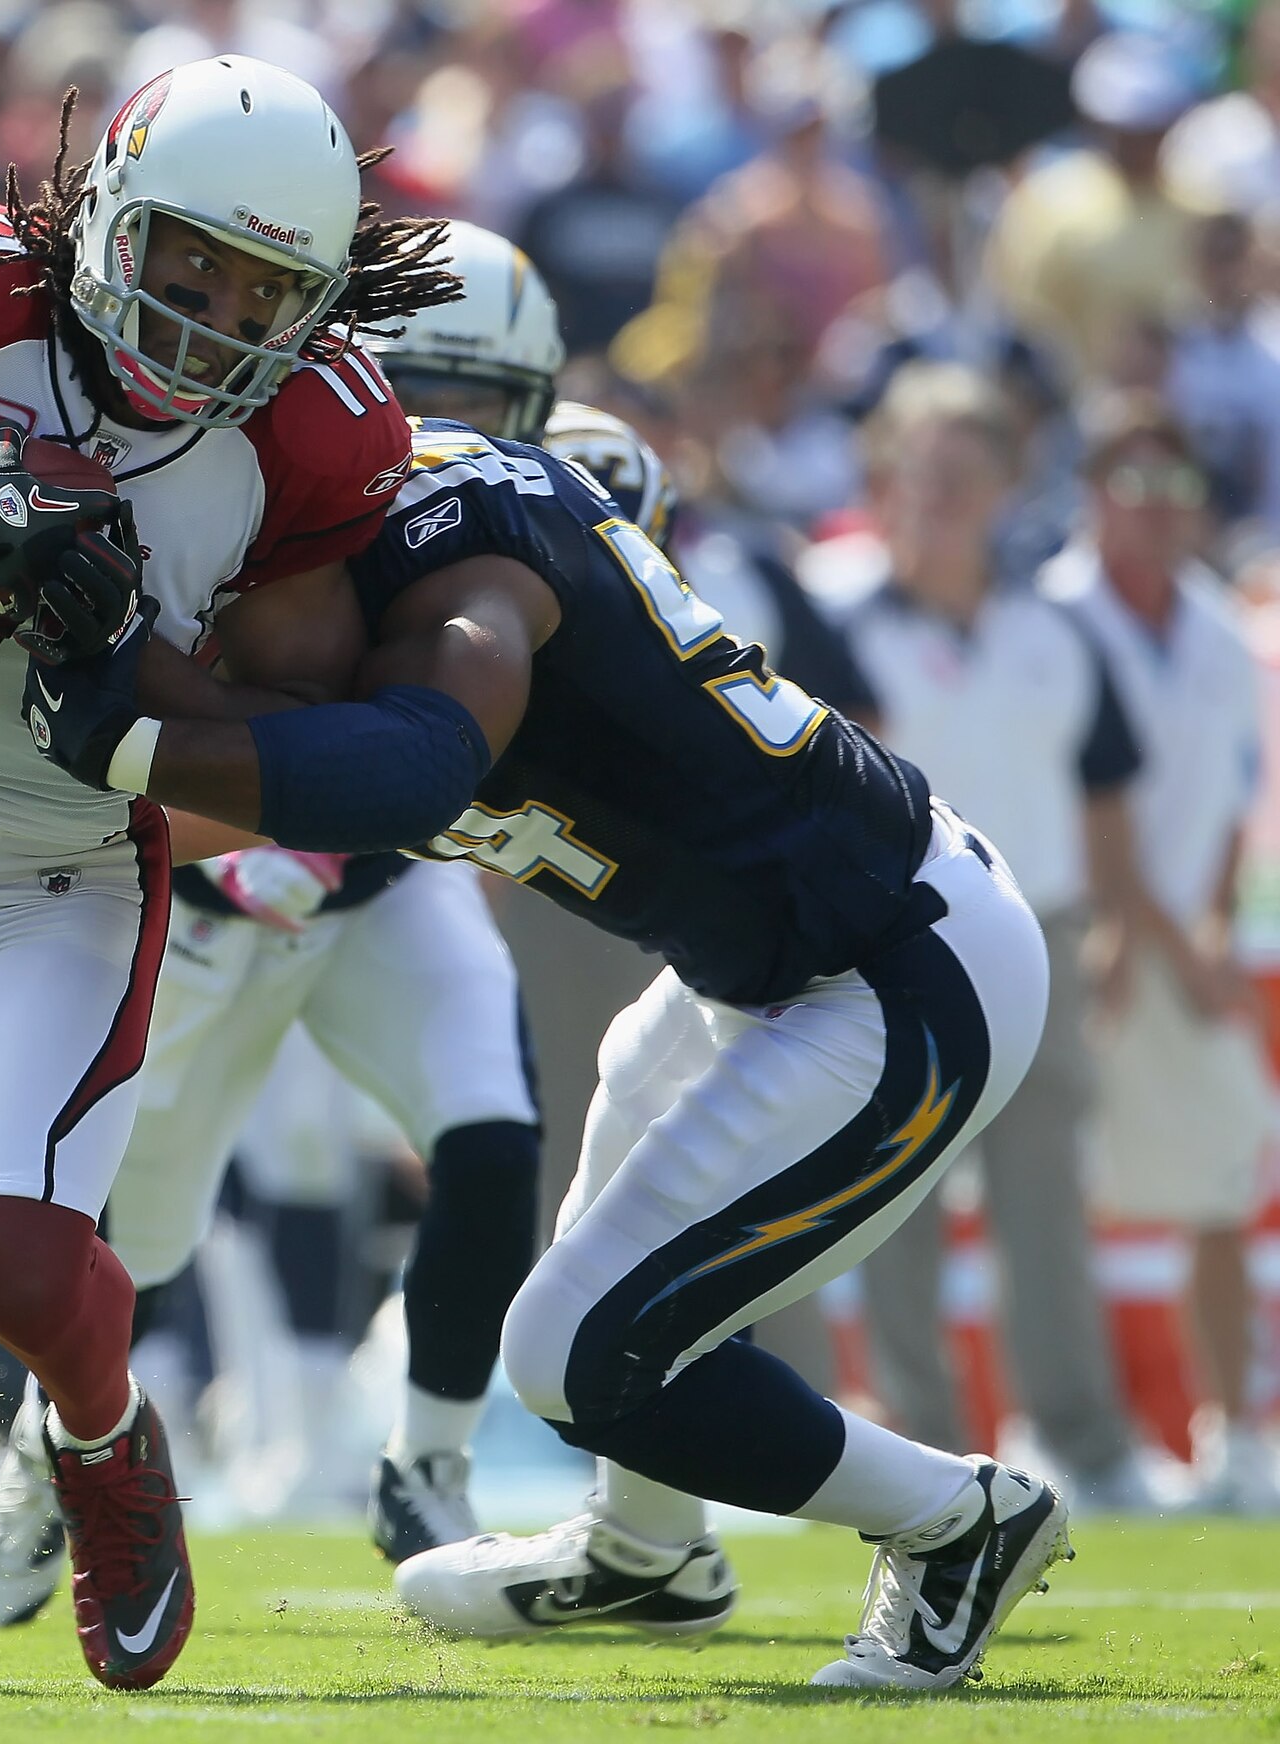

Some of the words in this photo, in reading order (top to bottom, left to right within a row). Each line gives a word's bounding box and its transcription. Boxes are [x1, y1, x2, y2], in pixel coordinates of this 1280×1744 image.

[246, 214, 297, 245] Riddell
[115, 234, 134, 286] Ridde
[312, 350, 389, 417] 11
